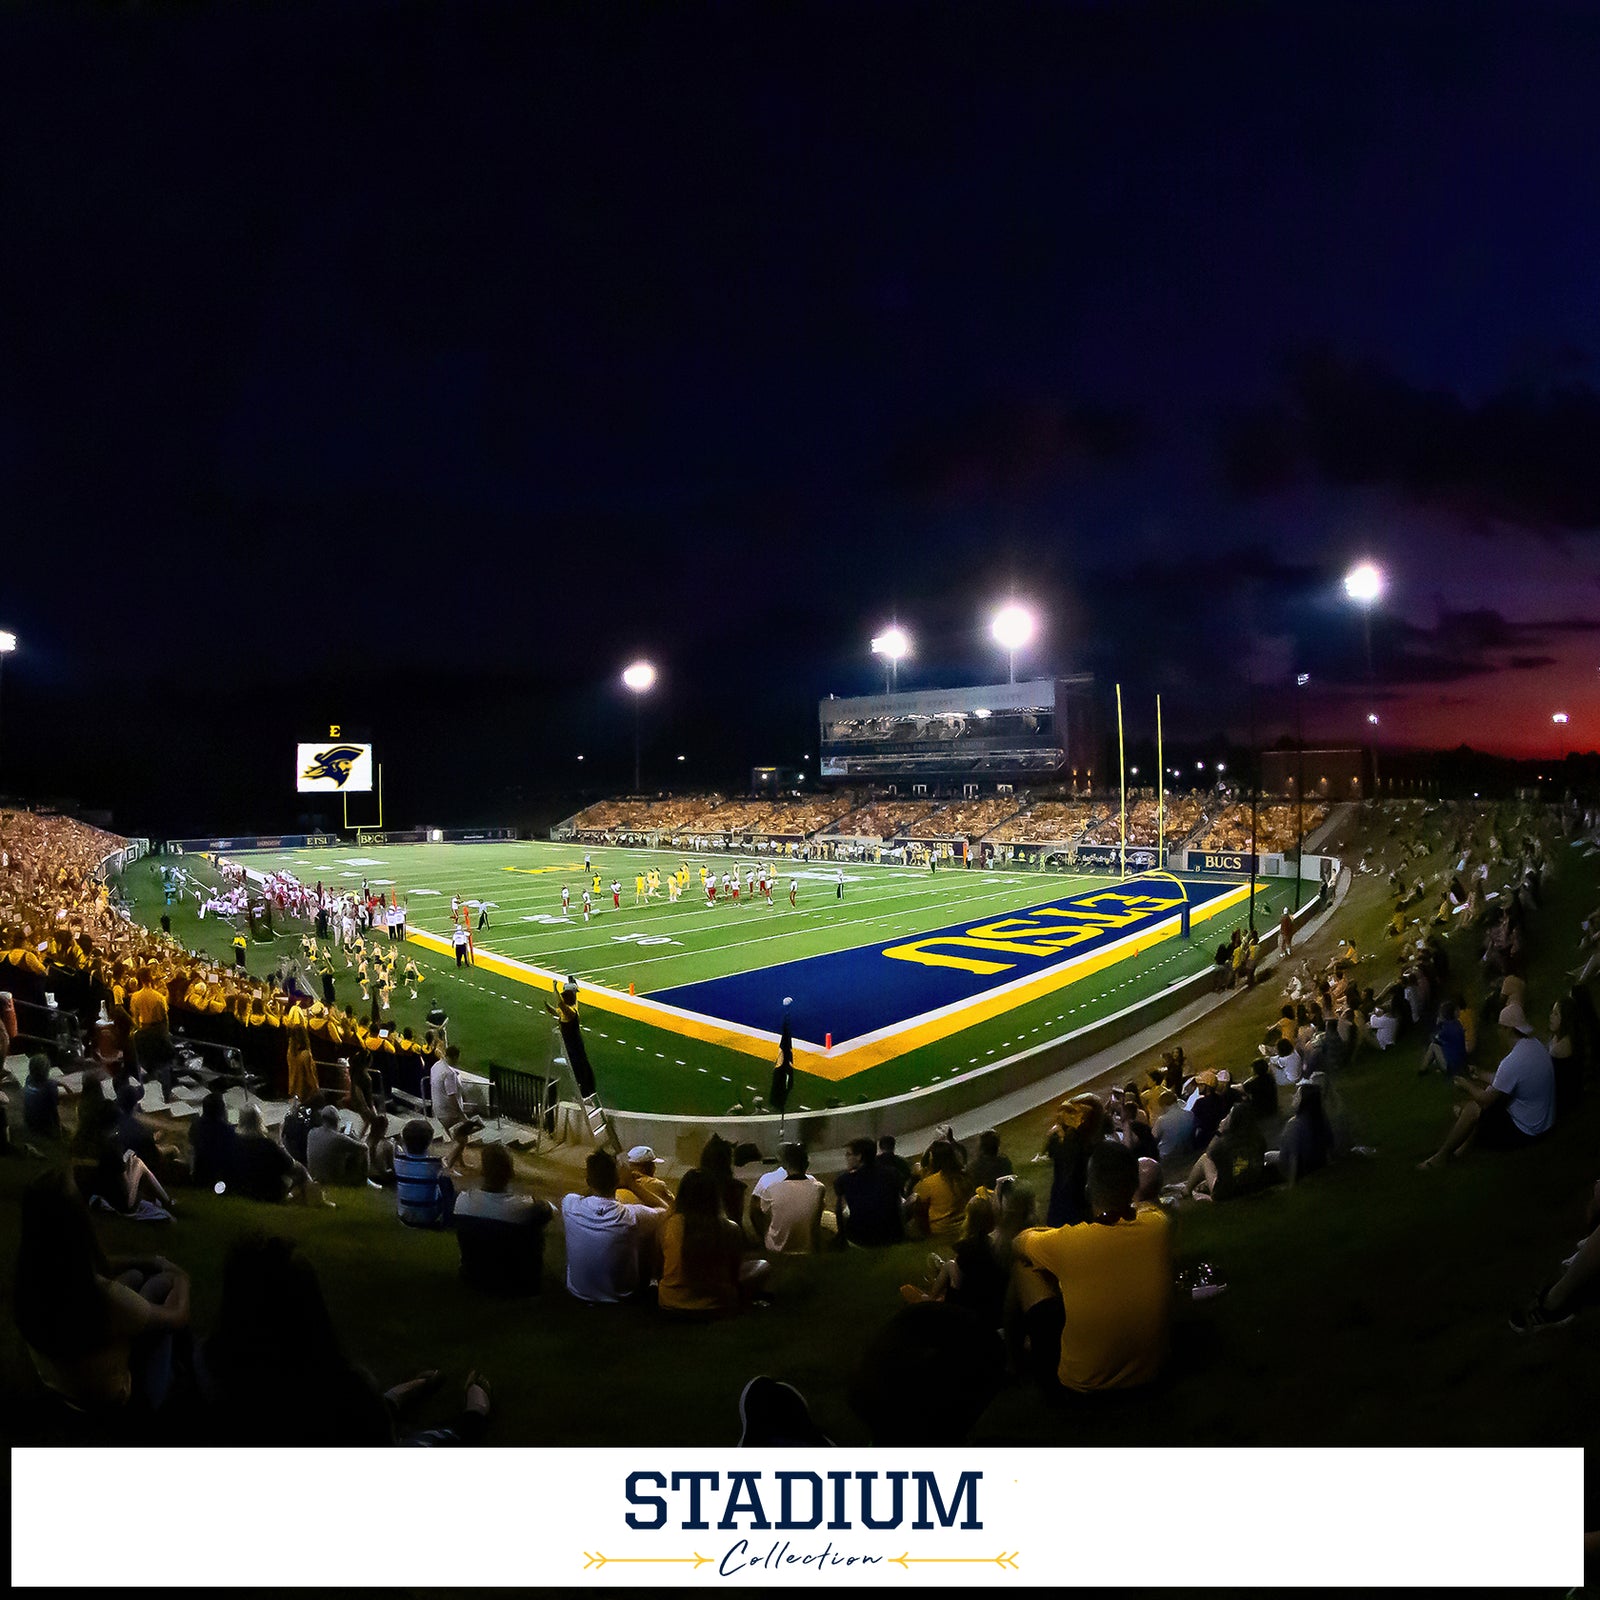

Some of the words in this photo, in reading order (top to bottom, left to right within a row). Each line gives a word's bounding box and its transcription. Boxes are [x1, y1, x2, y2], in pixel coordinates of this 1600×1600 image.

[329, 725, 341, 737] E
[1205, 855, 1242, 870] BUCS
[881, 892, 1186, 975] ETSU
